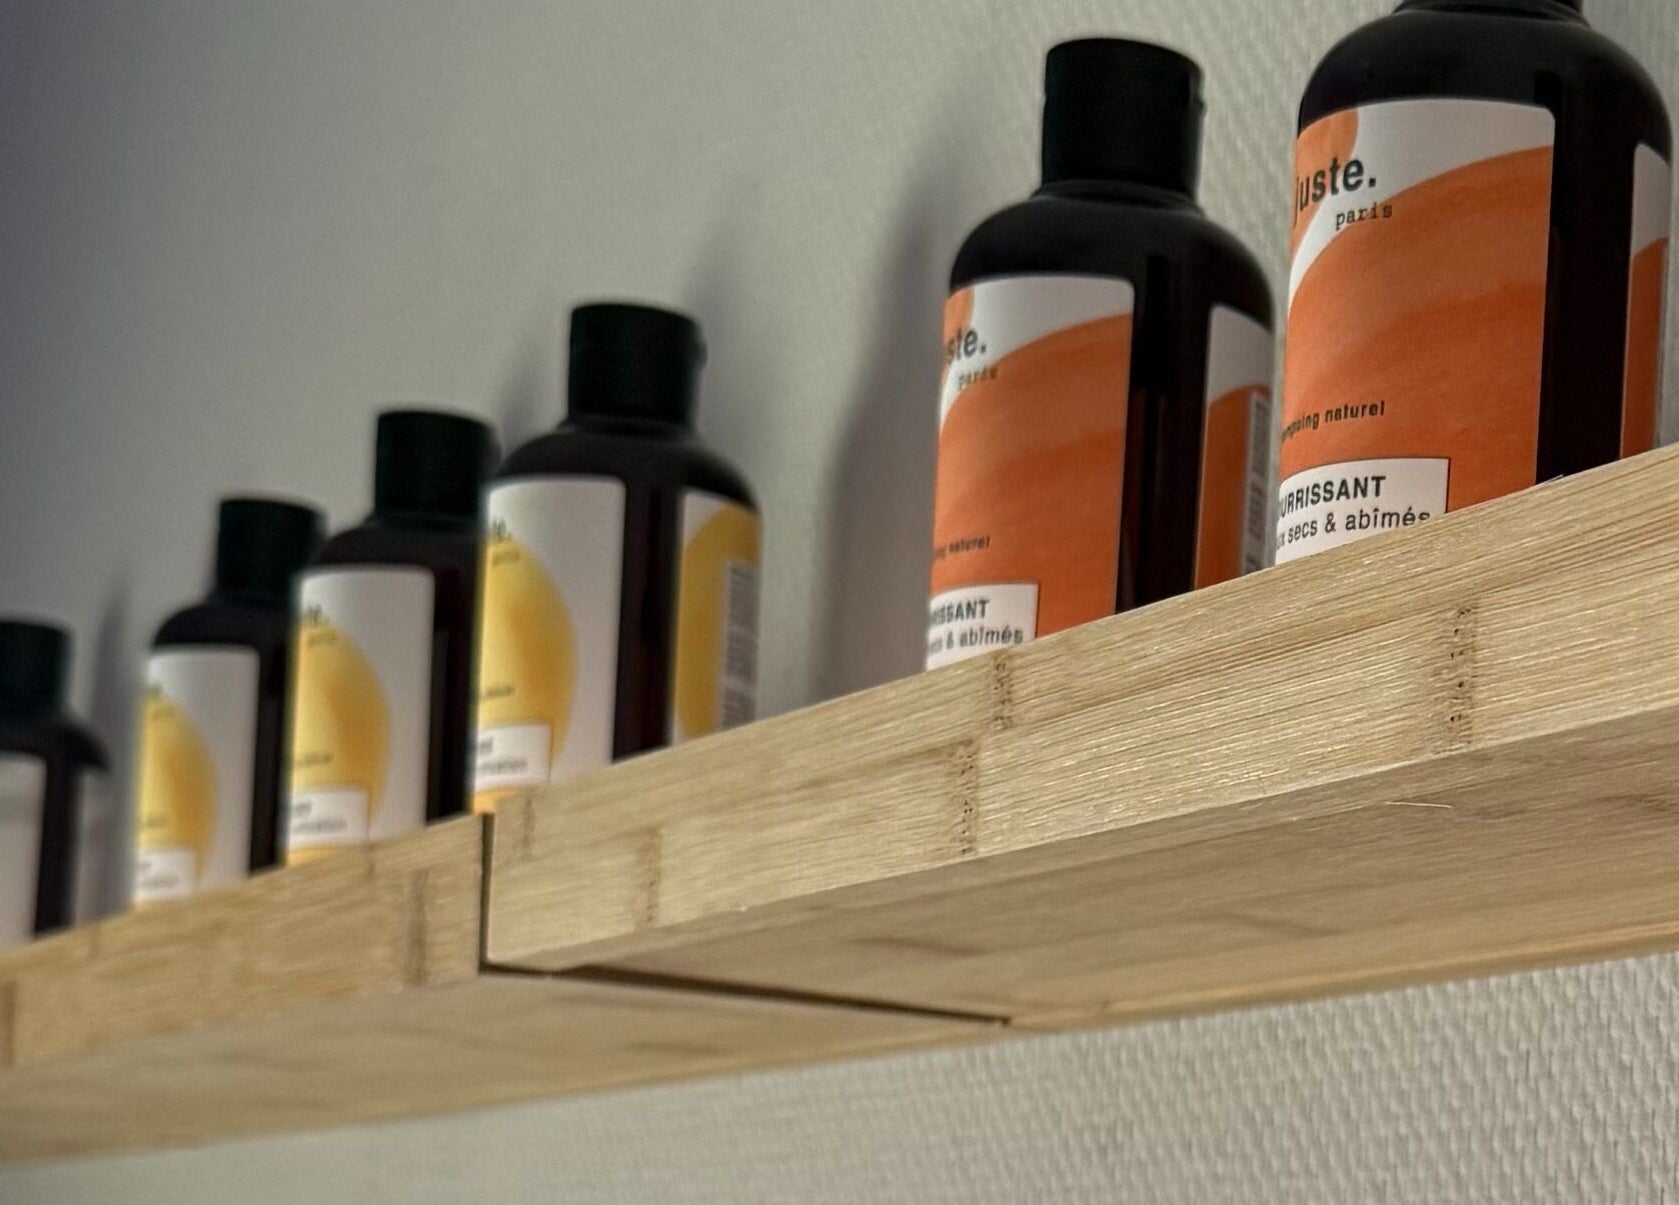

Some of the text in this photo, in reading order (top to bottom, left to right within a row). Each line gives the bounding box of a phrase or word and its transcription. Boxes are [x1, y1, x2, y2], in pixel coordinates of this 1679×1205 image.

[1335, 201, 1393, 231] paris
[1324, 400, 1386, 423] naturel
[1288, 519, 1318, 544] secs
[1324, 511, 1337, 534] &
